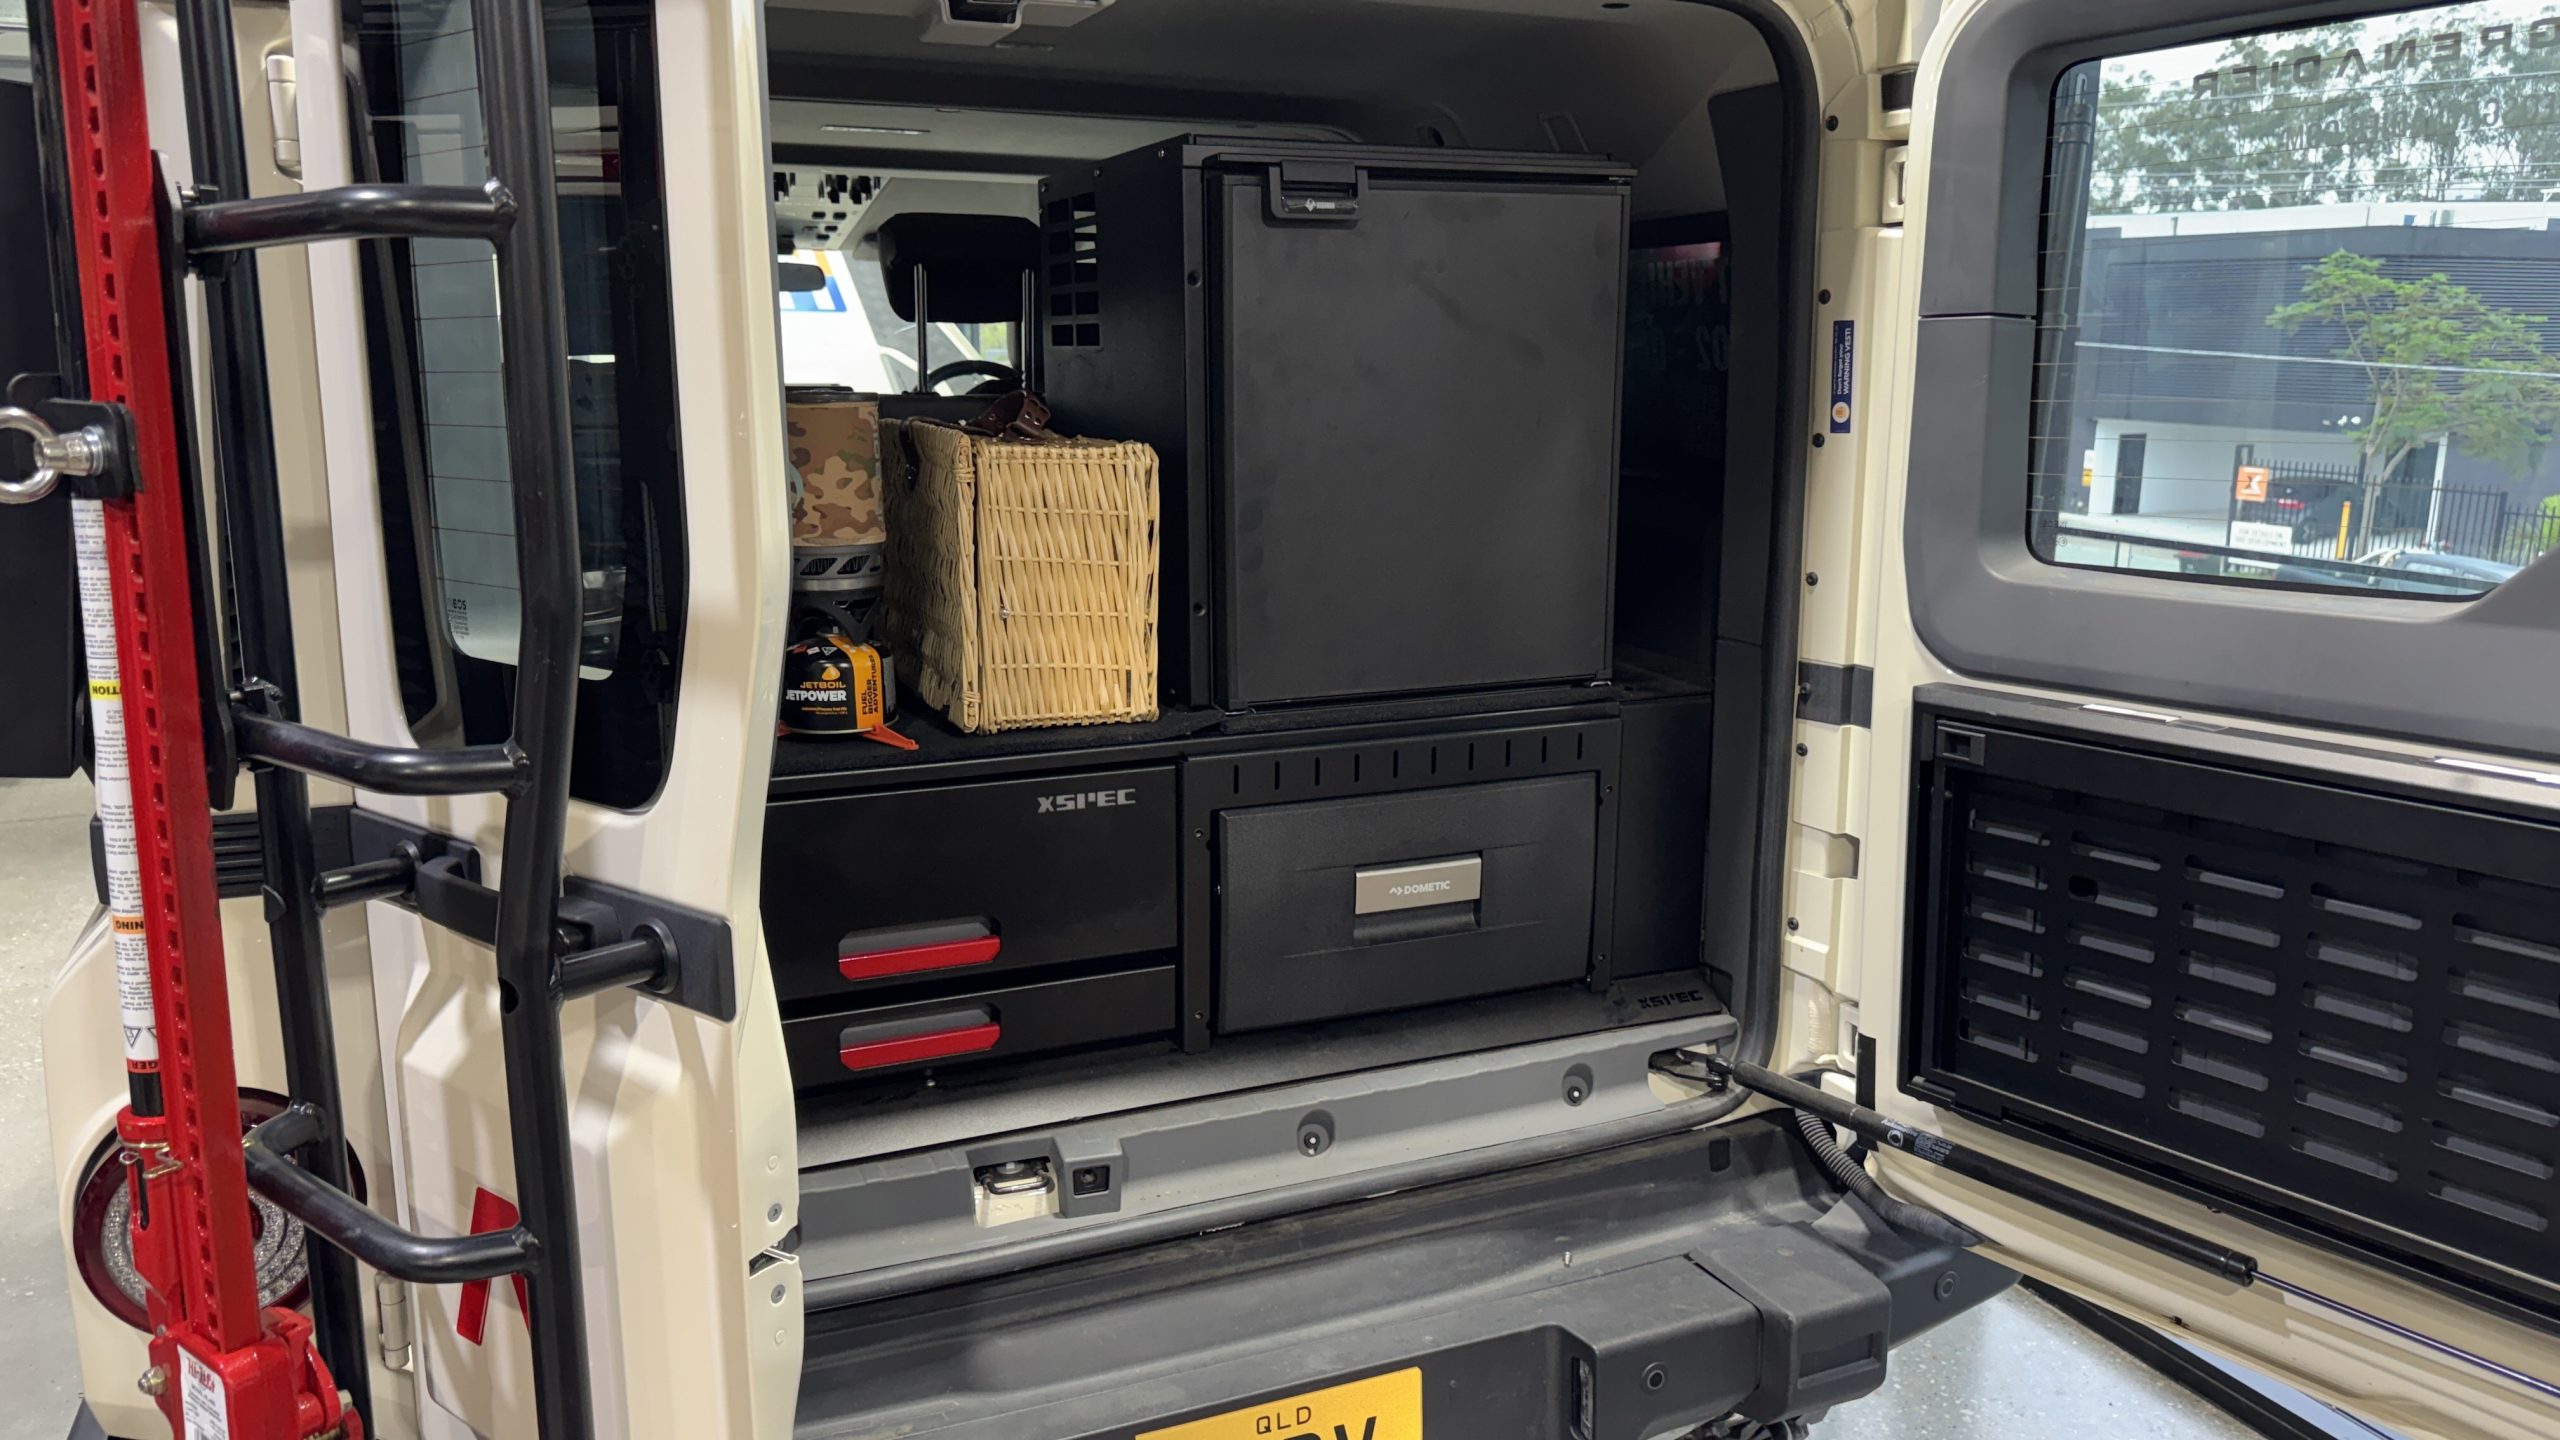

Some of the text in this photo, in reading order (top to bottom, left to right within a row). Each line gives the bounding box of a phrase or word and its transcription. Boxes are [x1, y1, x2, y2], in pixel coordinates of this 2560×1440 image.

[1843, 352, 1851, 395] WARNING
[92, 685, 121, 695] TION
[800, 681, 847, 689] JETBOIL
[785, 689, 848, 701] JETPOWER
[866, 679, 874, 715] BIGGER
[1037, 788, 1136, 813] XSPEC
[1403, 880, 1451, 895] DOMETIC
[115, 920, 145, 930] NING
[1256, 1405, 1312, 1435] QLD
